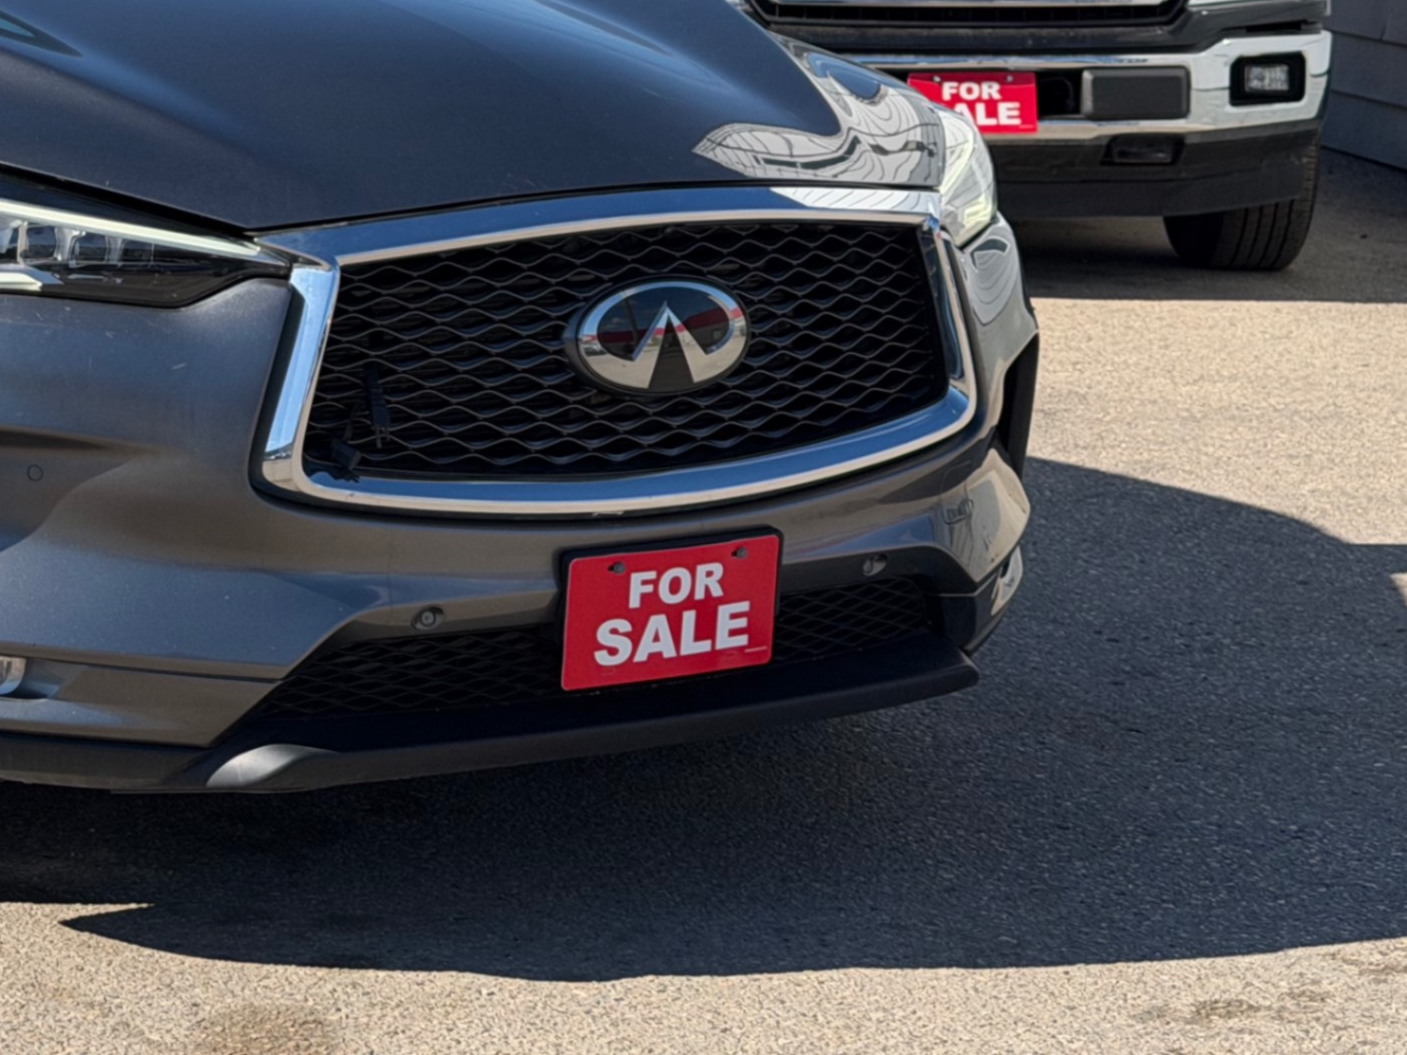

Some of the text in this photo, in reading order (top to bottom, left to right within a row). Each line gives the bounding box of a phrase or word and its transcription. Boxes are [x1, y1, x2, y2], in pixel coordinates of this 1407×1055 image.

[941, 81, 1002, 101] FOR
[952, 101, 1022, 126] ALE
[628, 561, 724, 609] FOR
[594, 600, 750, 667] SALE
